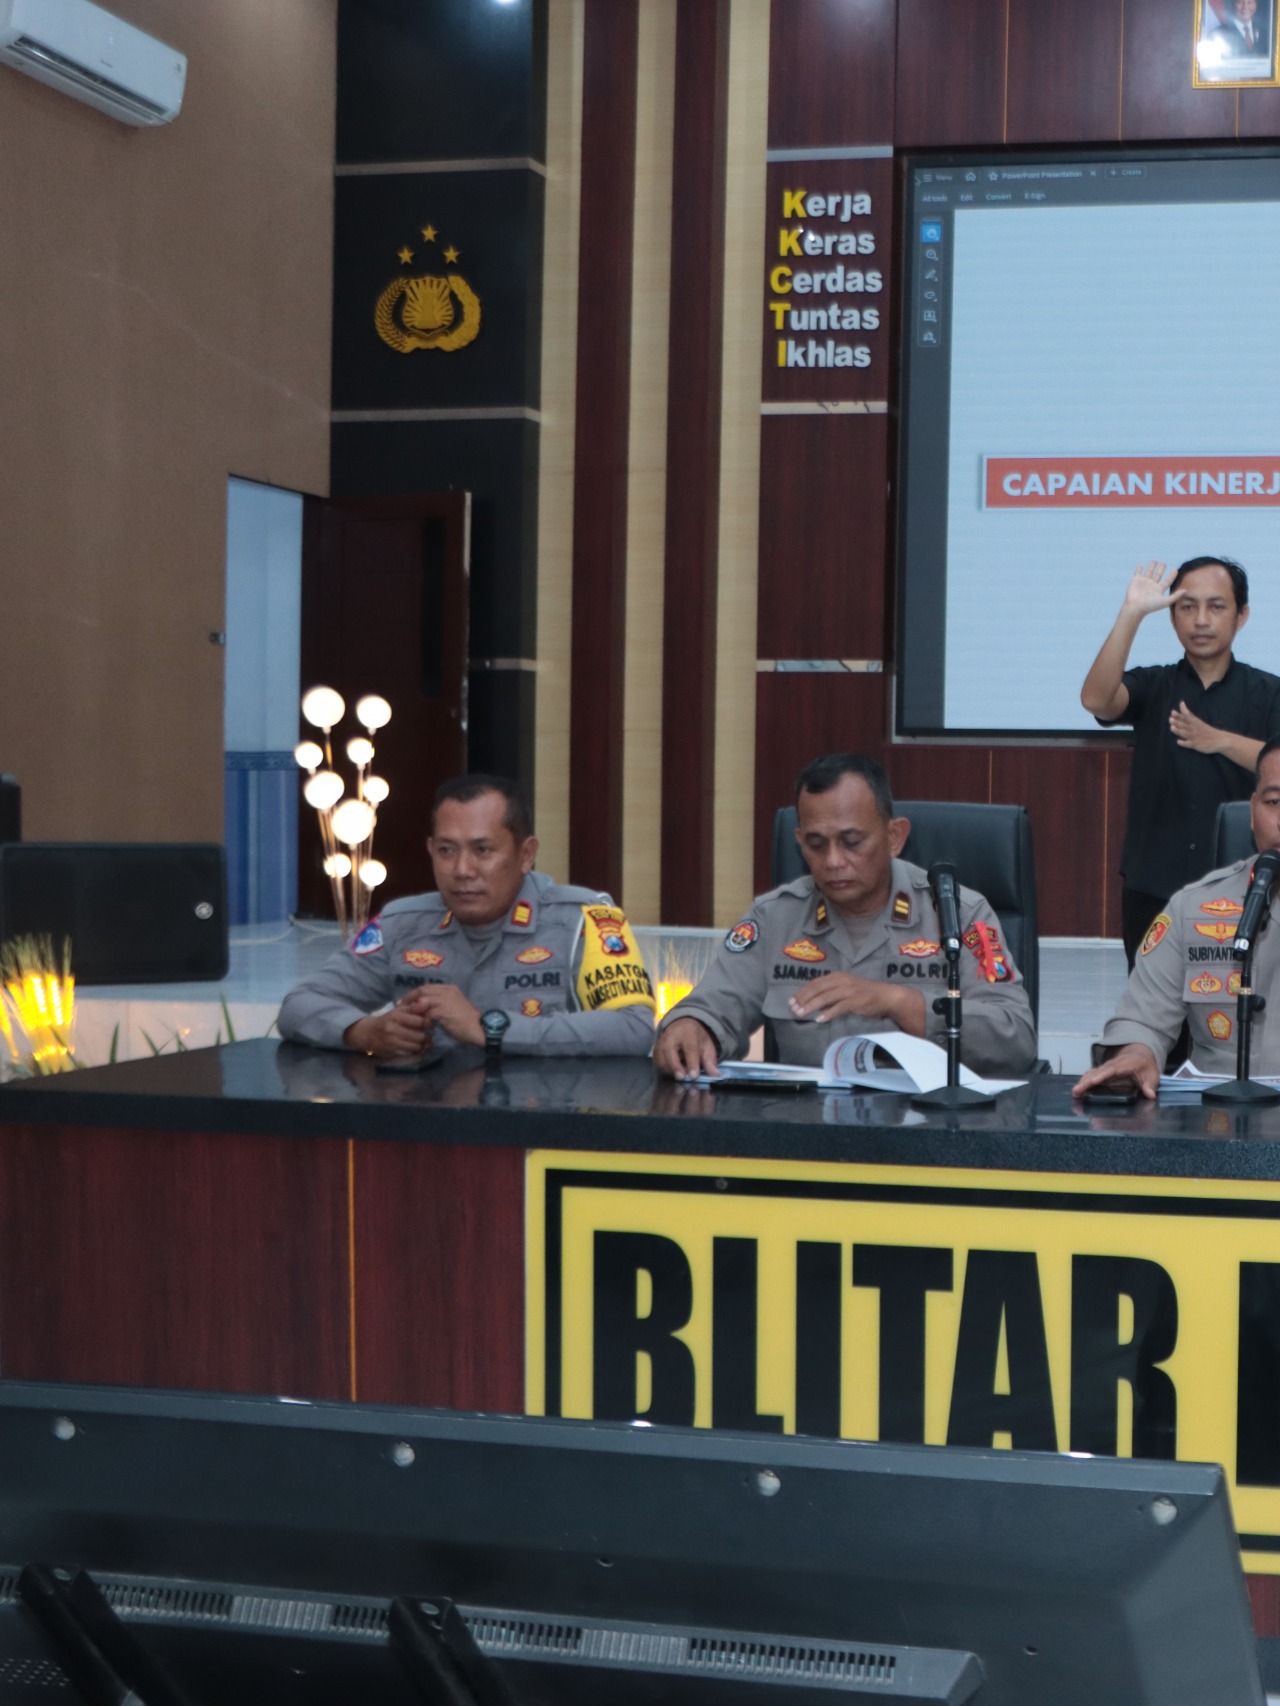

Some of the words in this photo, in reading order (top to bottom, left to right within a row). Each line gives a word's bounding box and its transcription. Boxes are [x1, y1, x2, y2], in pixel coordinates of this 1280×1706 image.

[1002, 171, 1040, 180] PowerPoint
[1041, 170, 1083, 179] Presentation
[783, 191, 872, 222] Kerja
[960, 194, 974, 202] Edit
[986, 192, 1012, 201] Convert
[1024, 191, 1046, 201] E-Sign
[779, 229, 876, 256] Keras
[770, 265, 883, 293] Cerdas
[769, 303, 880, 330] Tuntas
[778, 340, 871, 368] Ikhlas
[1003, 473, 1152, 496] CAPAIAN
[505, 971, 560, 989] POLRI
[886, 962, 948, 979] POLRI
[593, 1229, 1179, 1462] BLITAR
